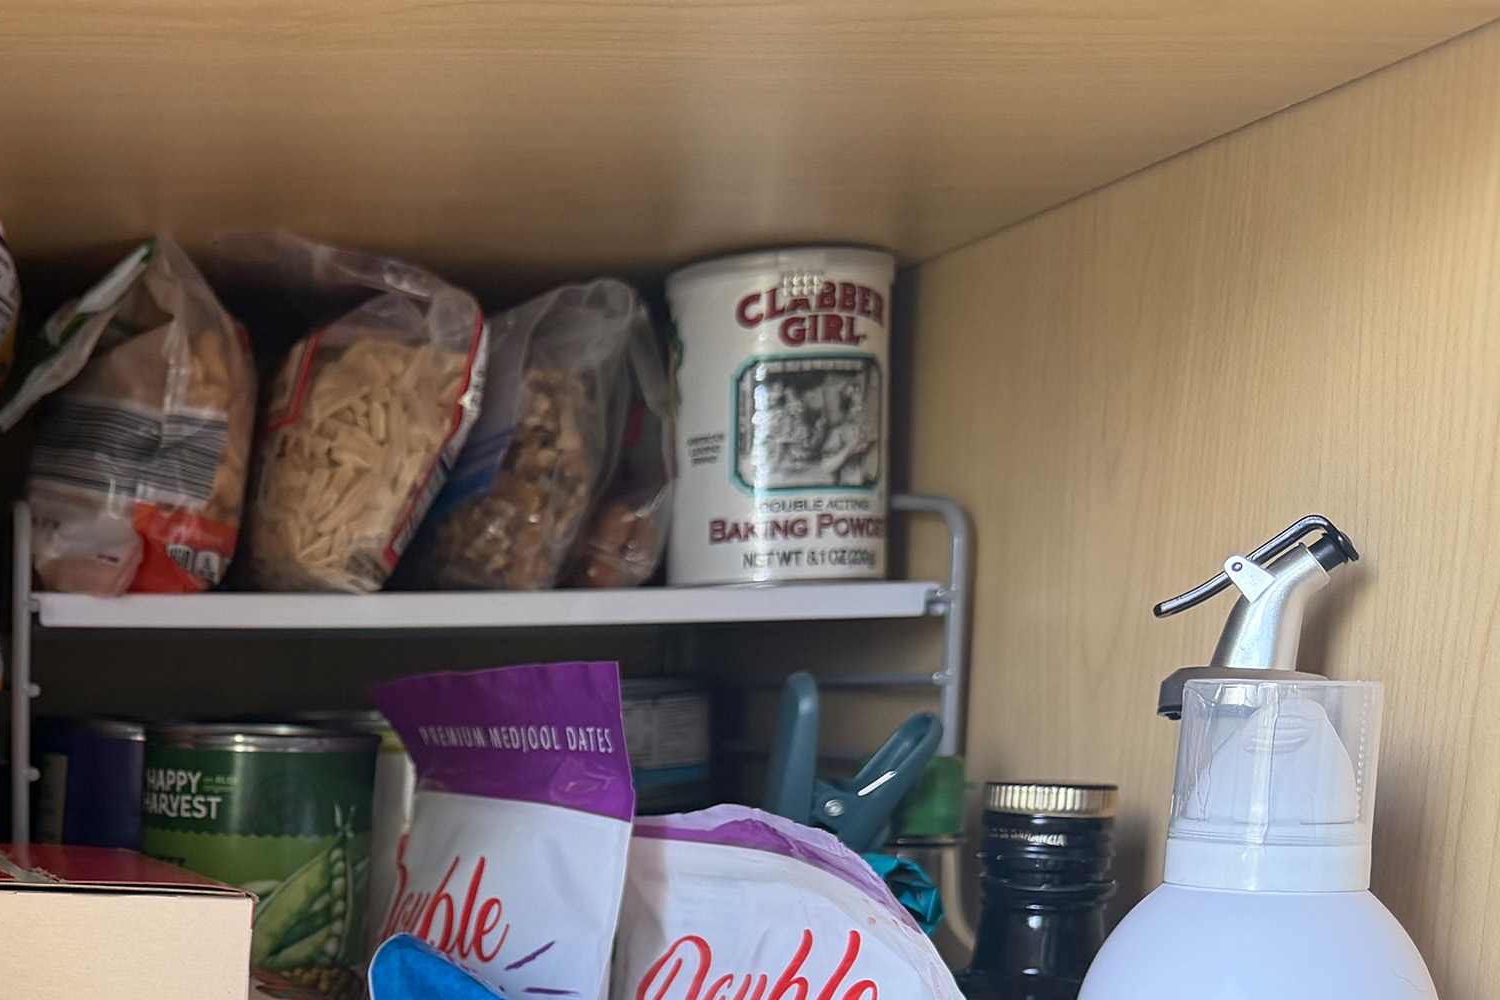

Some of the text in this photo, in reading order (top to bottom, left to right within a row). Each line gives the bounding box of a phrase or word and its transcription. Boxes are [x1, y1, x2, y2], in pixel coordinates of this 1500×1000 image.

[779, 313, 860, 347] GIRL
[418, 725, 614, 756] PREMIUM MEDJOOL DATES
[146, 768, 201, 793] HAPPY
